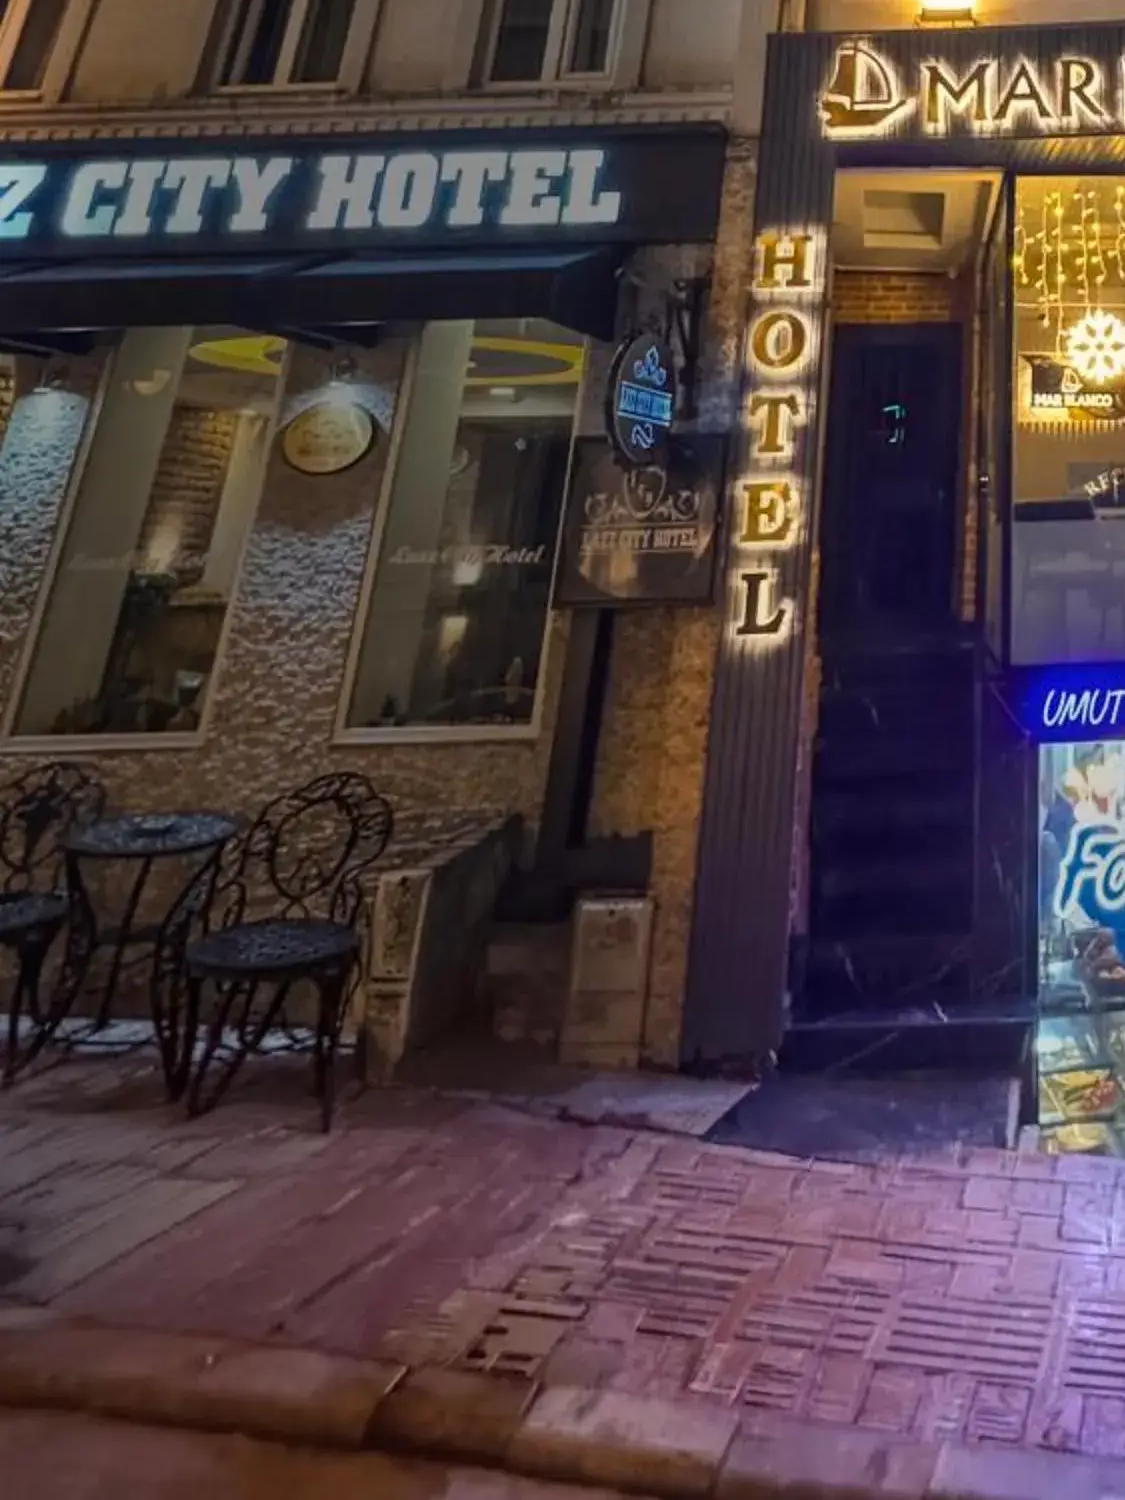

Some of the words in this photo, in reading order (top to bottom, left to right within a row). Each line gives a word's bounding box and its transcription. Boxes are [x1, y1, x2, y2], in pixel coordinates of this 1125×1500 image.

[923, 56, 1100, 126] MAR
[61, 157, 293, 236] CITY
[306, 149, 622, 230] HOTEL
[737, 232, 816, 640] HOTEL
[1063, 391, 1113, 408] BLANCO
